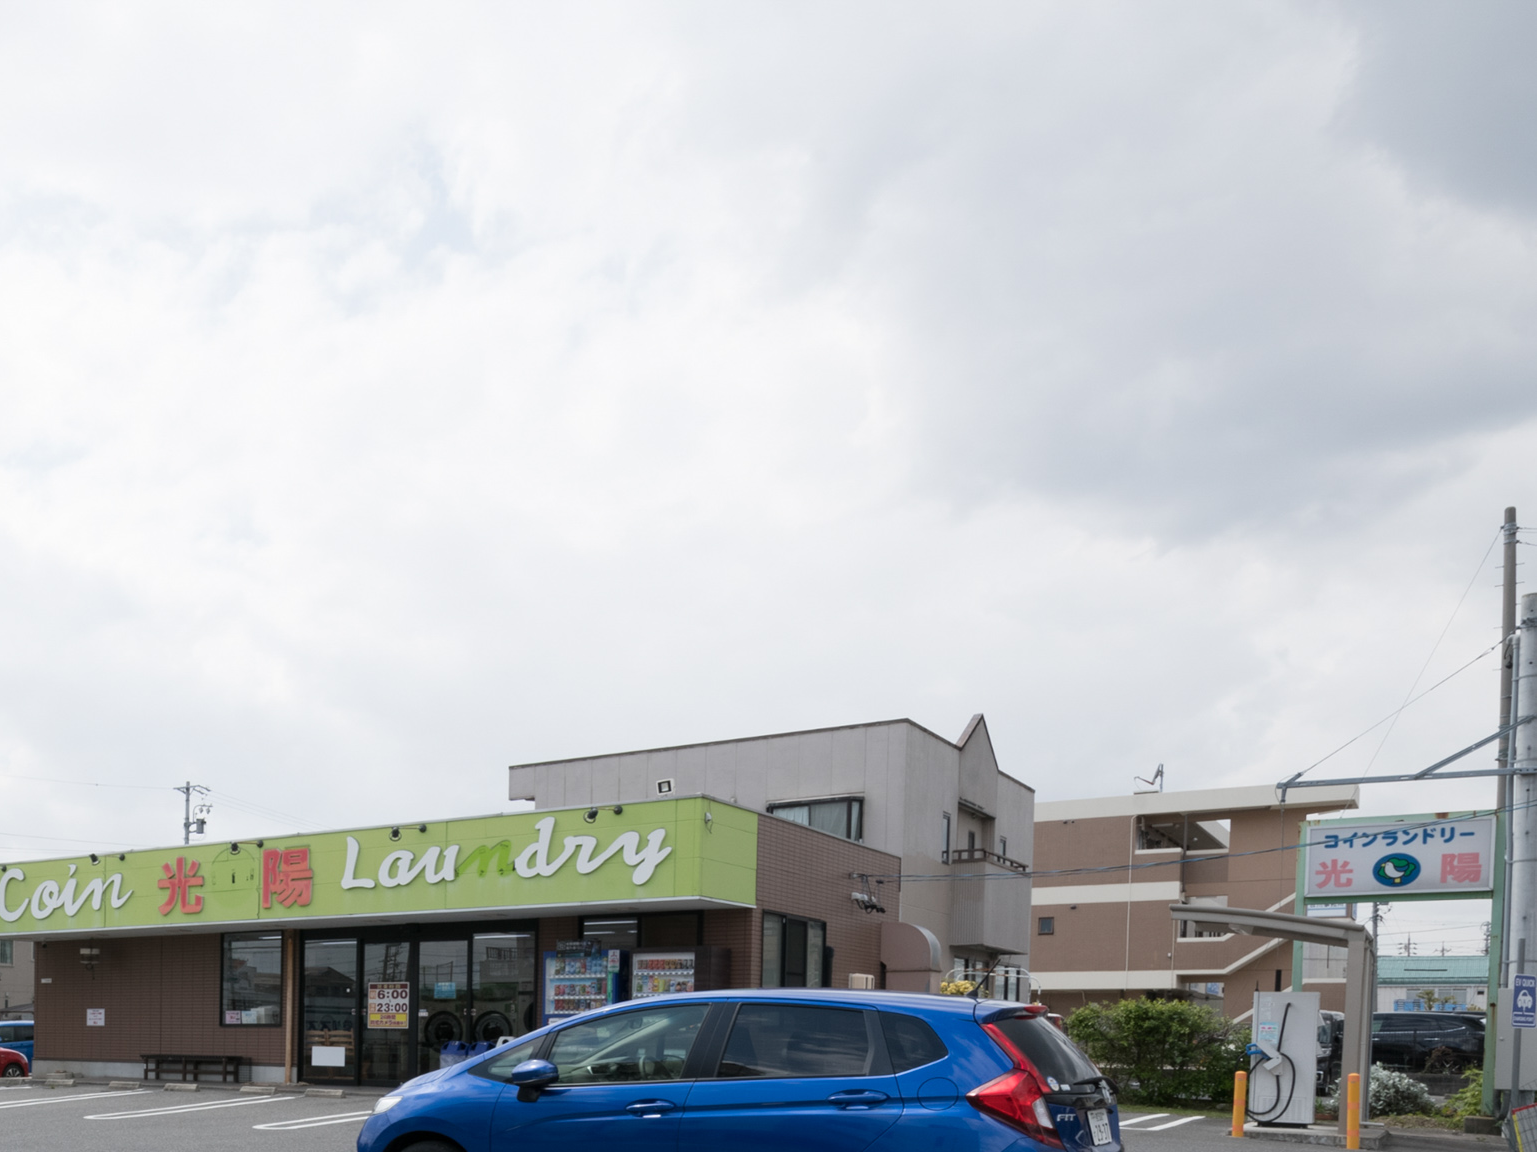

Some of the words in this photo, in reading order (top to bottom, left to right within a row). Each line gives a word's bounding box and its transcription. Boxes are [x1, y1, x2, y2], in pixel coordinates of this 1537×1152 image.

[1324, 826, 1475, 849] コインランドリー
[157, 855, 205, 917] 光
[262, 846, 313, 910] 陽
[340, 816, 673, 890] Laundry
[1315, 858, 1354, 889] 光
[1440, 852, 1482, 884] 陽
[377, 989, 408, 999] 6:00
[376, 1002, 408, 1012] 23:00
[1056, 1113, 1077, 1122] FIT
